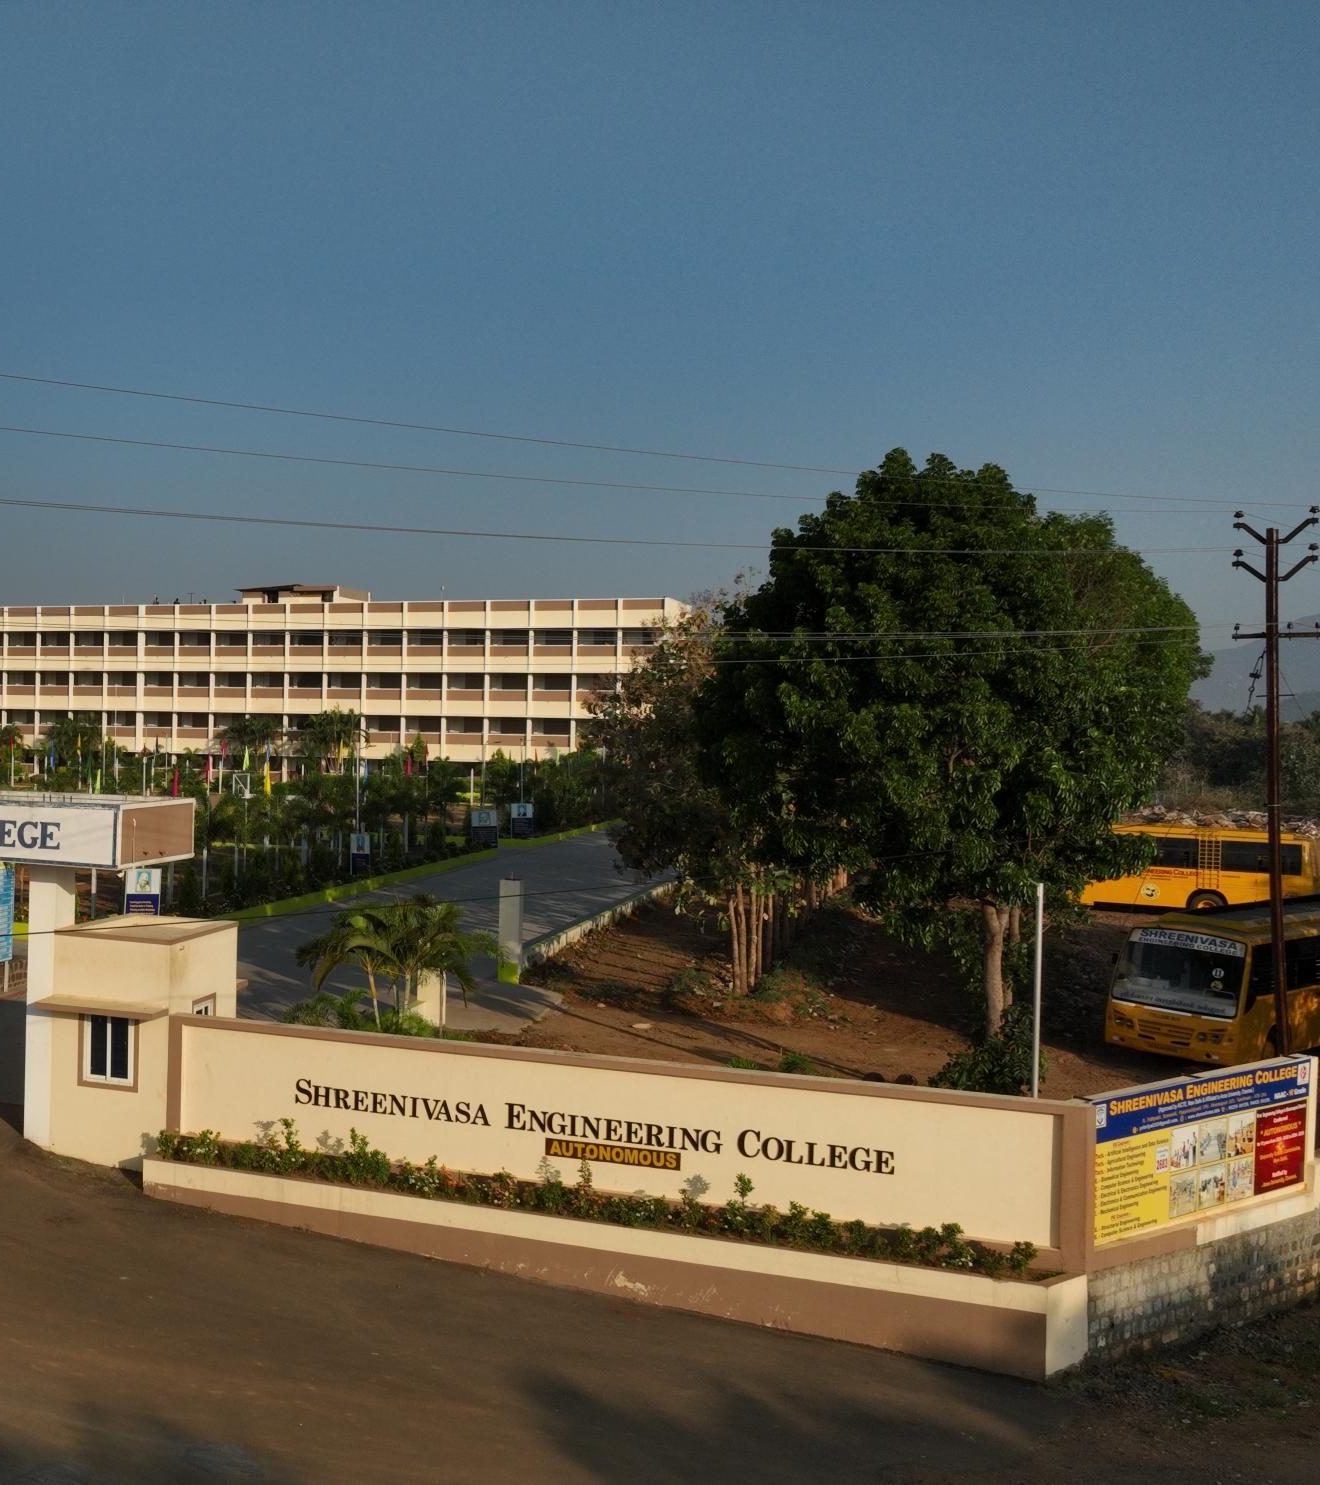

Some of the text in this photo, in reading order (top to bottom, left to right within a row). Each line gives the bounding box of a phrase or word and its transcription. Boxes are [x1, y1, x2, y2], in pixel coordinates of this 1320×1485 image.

[1139, 928, 1238, 950] SHREENIVASA
[1110, 1089, 1184, 1116] SHREENIVASA
[1186, 1074, 1253, 1099] ENGINEERING
[1255, 1065, 1298, 1085] COLLEGE
[294, 1078, 896, 1176] SHREENIVASA ENGINEERING COLLEGE
[549, 1142, 678, 1168] AUTONOMOUS
